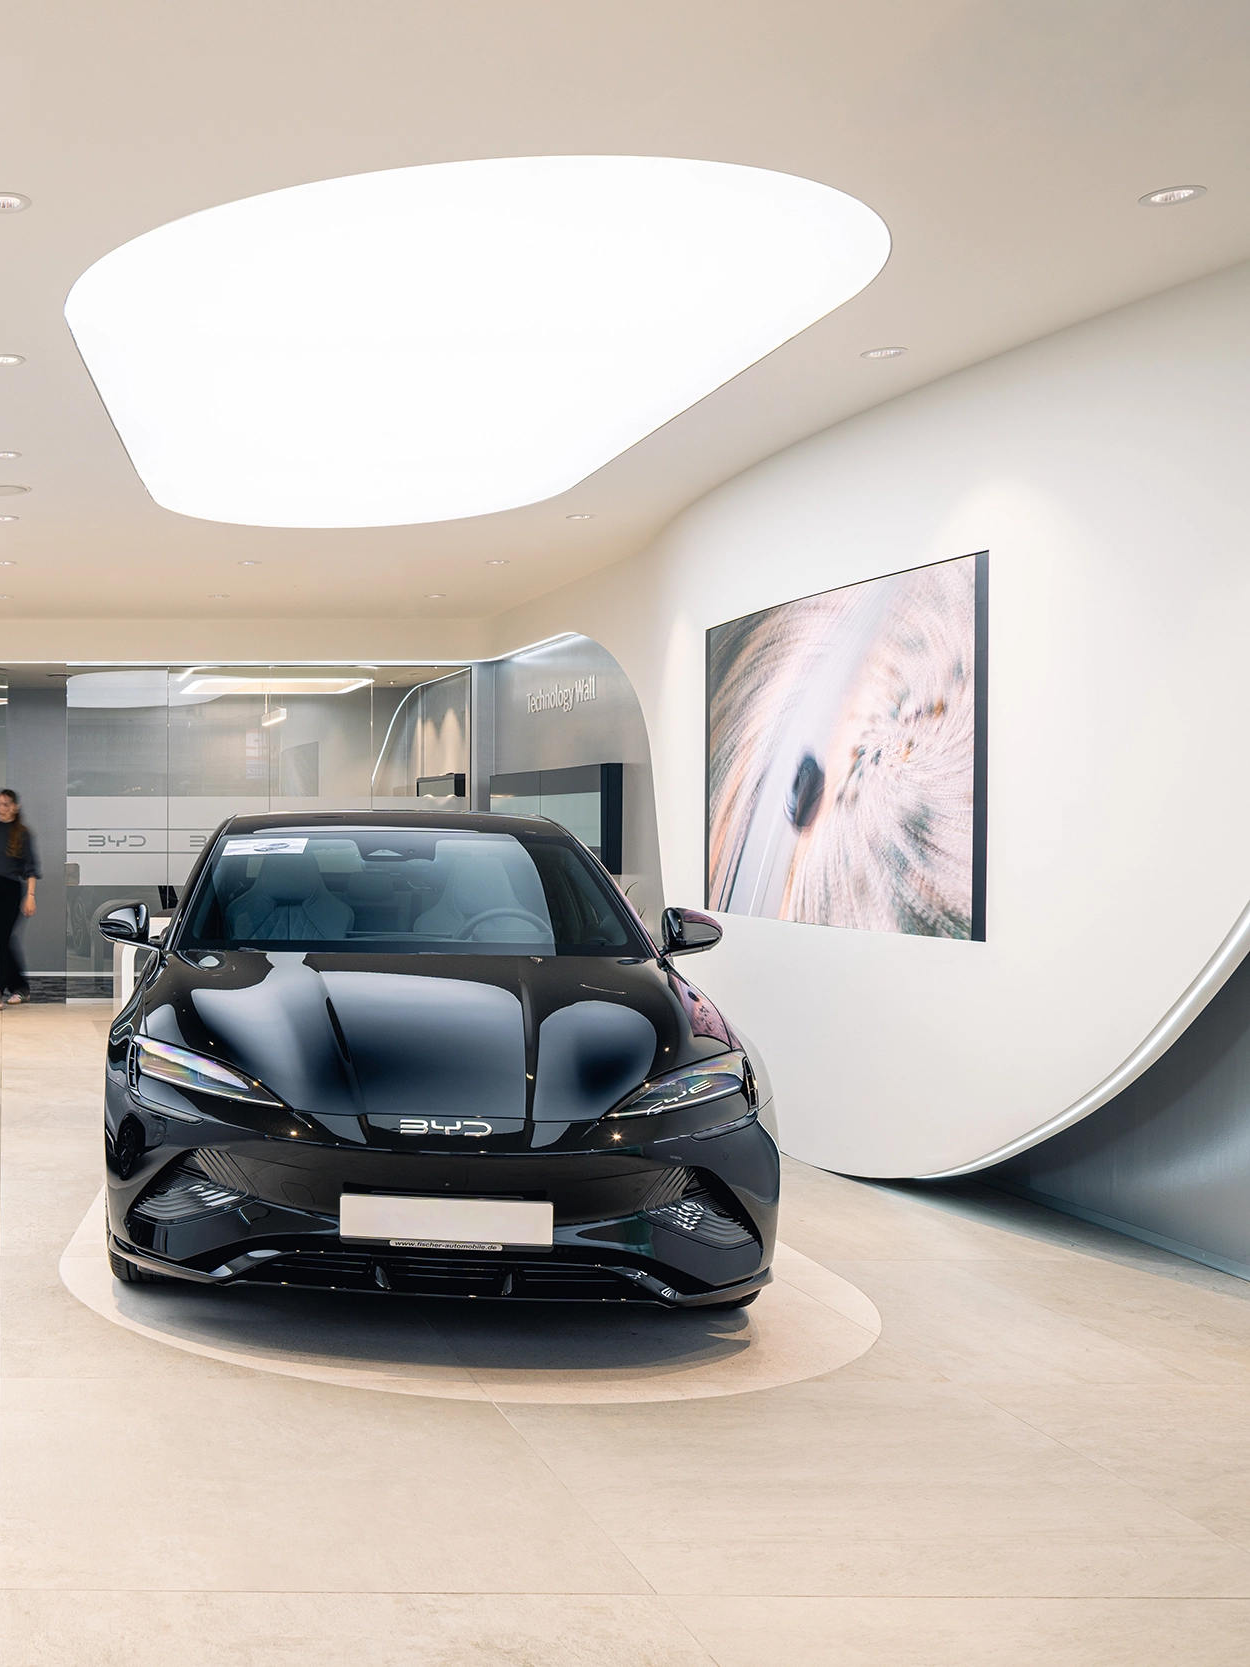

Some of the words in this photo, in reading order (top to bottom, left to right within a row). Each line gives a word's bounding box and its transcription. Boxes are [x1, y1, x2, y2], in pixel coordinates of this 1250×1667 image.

[526, 684, 575, 714] Technology
[575, 674, 597, 703] Wall
[88, 835, 147, 847] BYD
[400, 1119, 493, 1137] BYD
[394, 1241, 497, 1251] www.fischer-automobile.de
